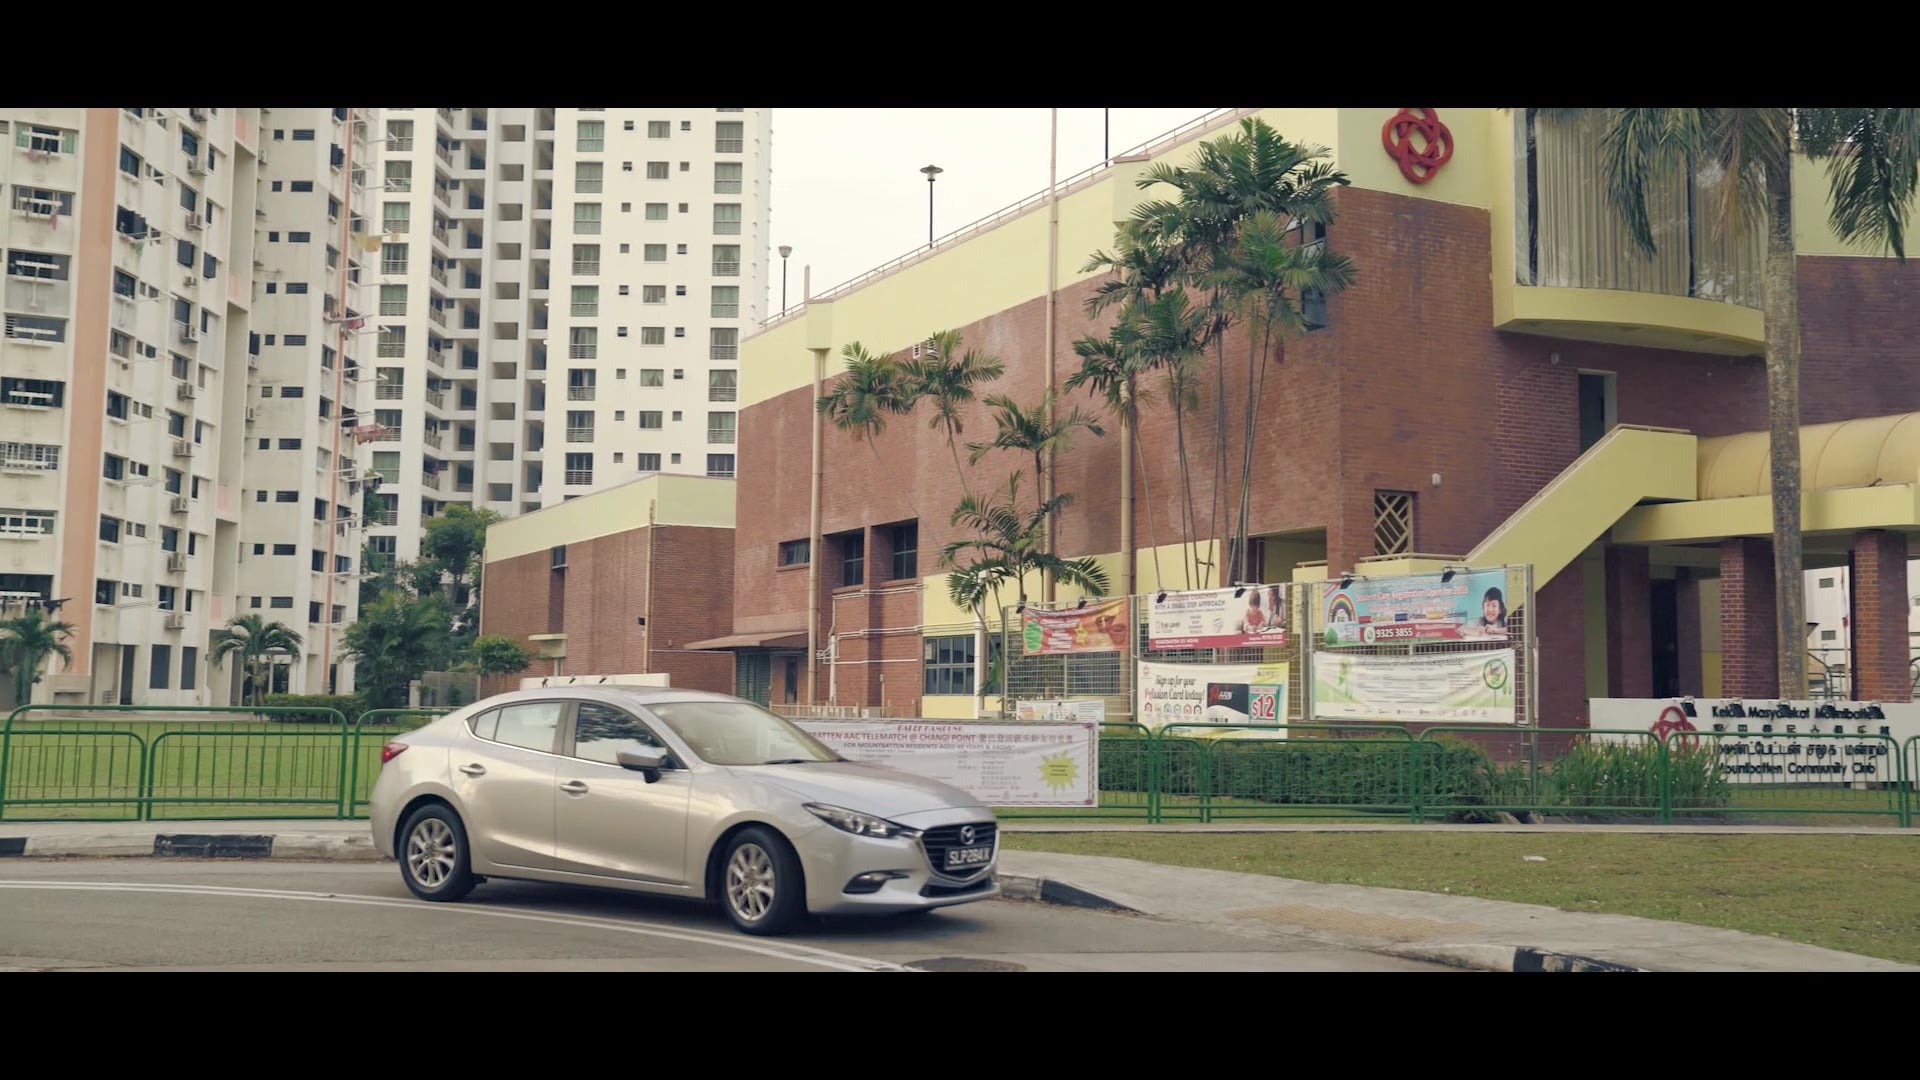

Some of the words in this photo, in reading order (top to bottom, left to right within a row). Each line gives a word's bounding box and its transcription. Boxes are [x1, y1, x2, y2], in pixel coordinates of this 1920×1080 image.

[1375, 628, 1393, 638] 9325
[1155, 674, 1167, 688] Sign
[1252, 695, 1274, 718] $12
[844, 732, 861, 740] AAC
[862, 732, 907, 741] TELEMATCH
[910, 733, 918, 741] @
[1788, 762, 1847, 776] Community
